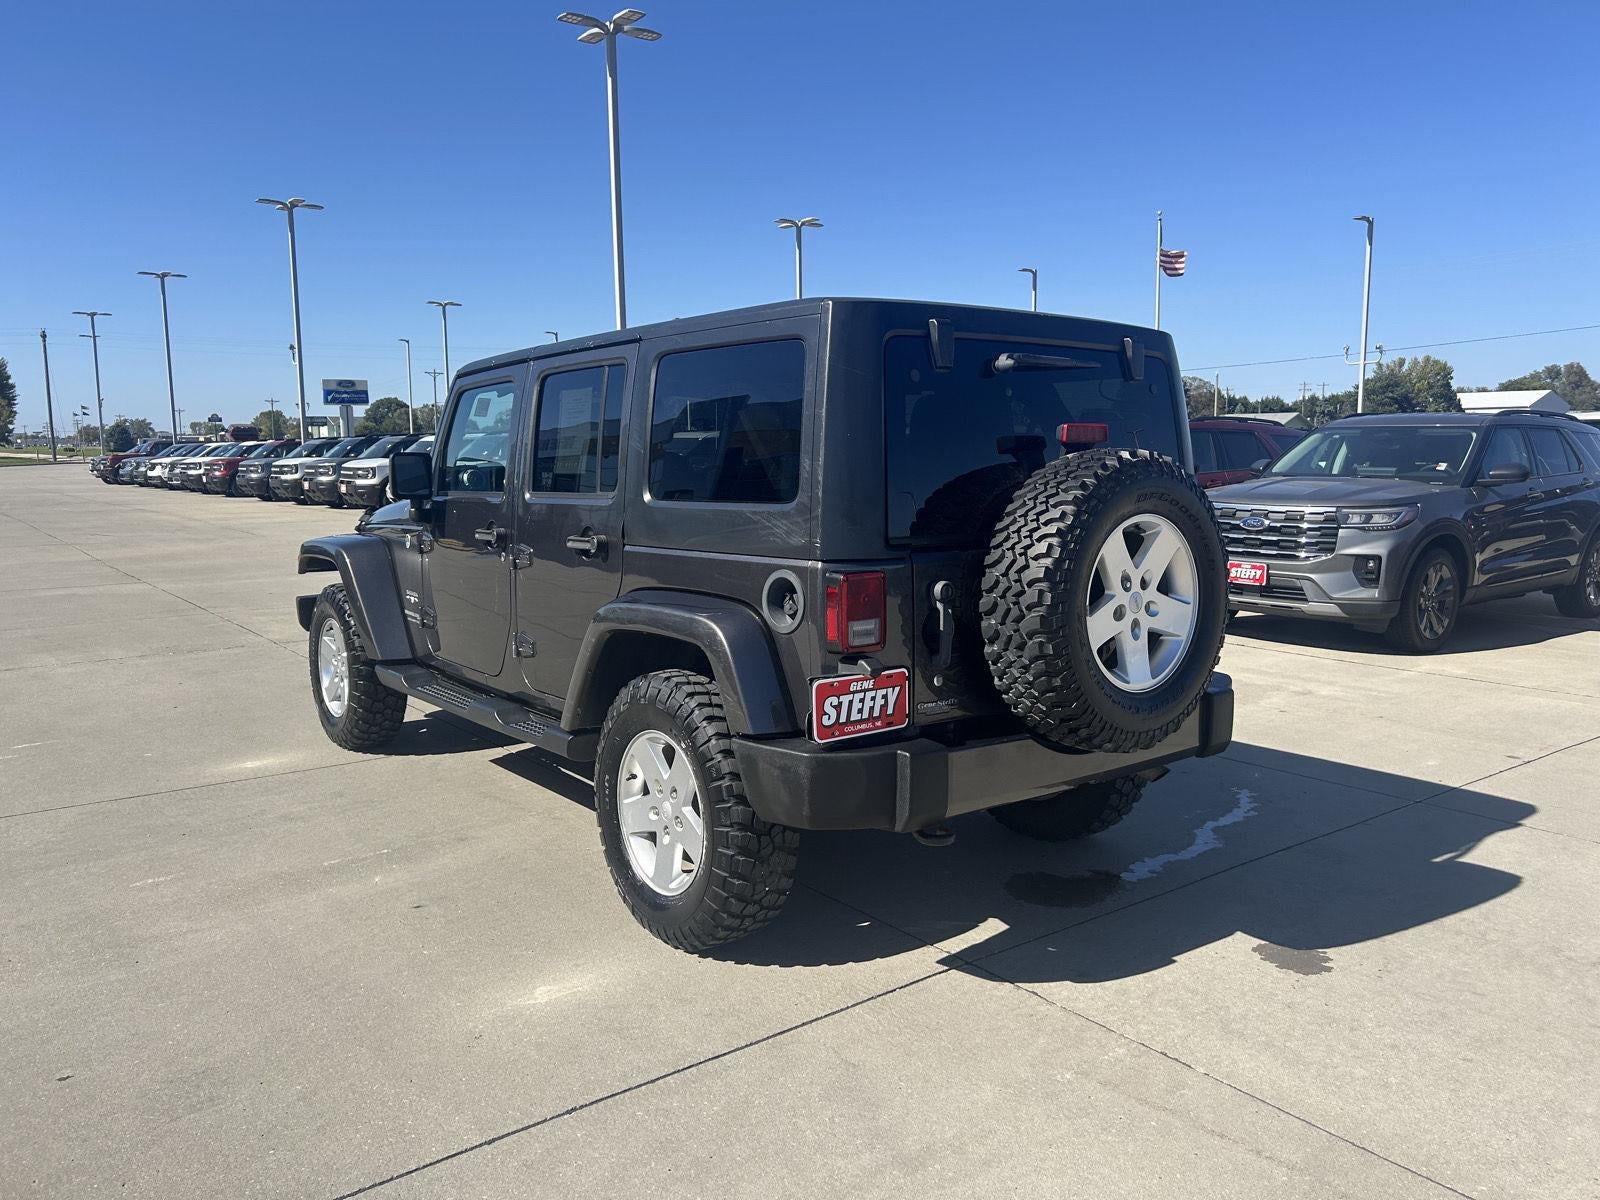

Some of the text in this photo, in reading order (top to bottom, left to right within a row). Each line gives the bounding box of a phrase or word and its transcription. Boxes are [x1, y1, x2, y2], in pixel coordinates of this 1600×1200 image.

[1230, 567, 1263, 579] STEFFY
[850, 679, 875, 692] GENE
[822, 686, 901, 726] STEFFY
